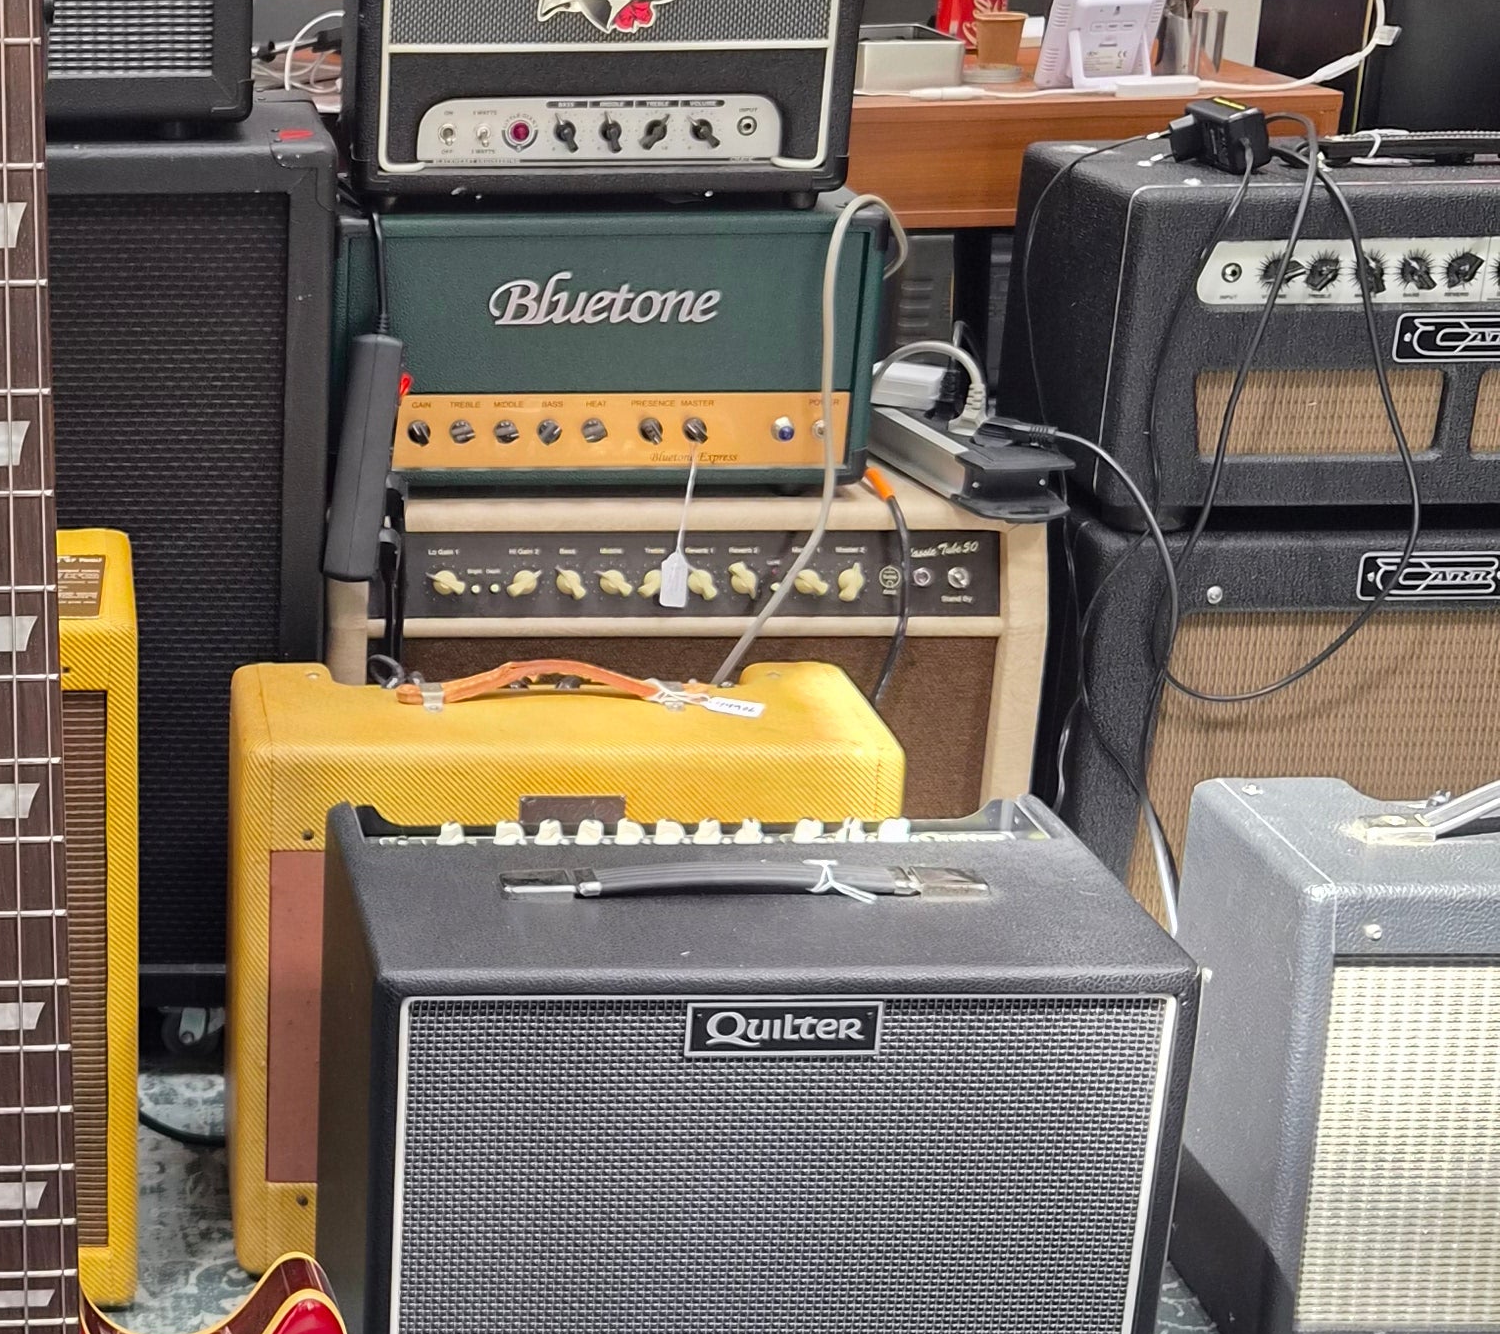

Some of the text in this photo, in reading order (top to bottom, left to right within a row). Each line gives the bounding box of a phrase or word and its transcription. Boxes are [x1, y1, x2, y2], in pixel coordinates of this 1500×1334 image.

[489, 271, 721, 324] Bluetone
[651, 451, 738, 464] Blueton Express
[706, 1011, 866, 1047] Quilter
